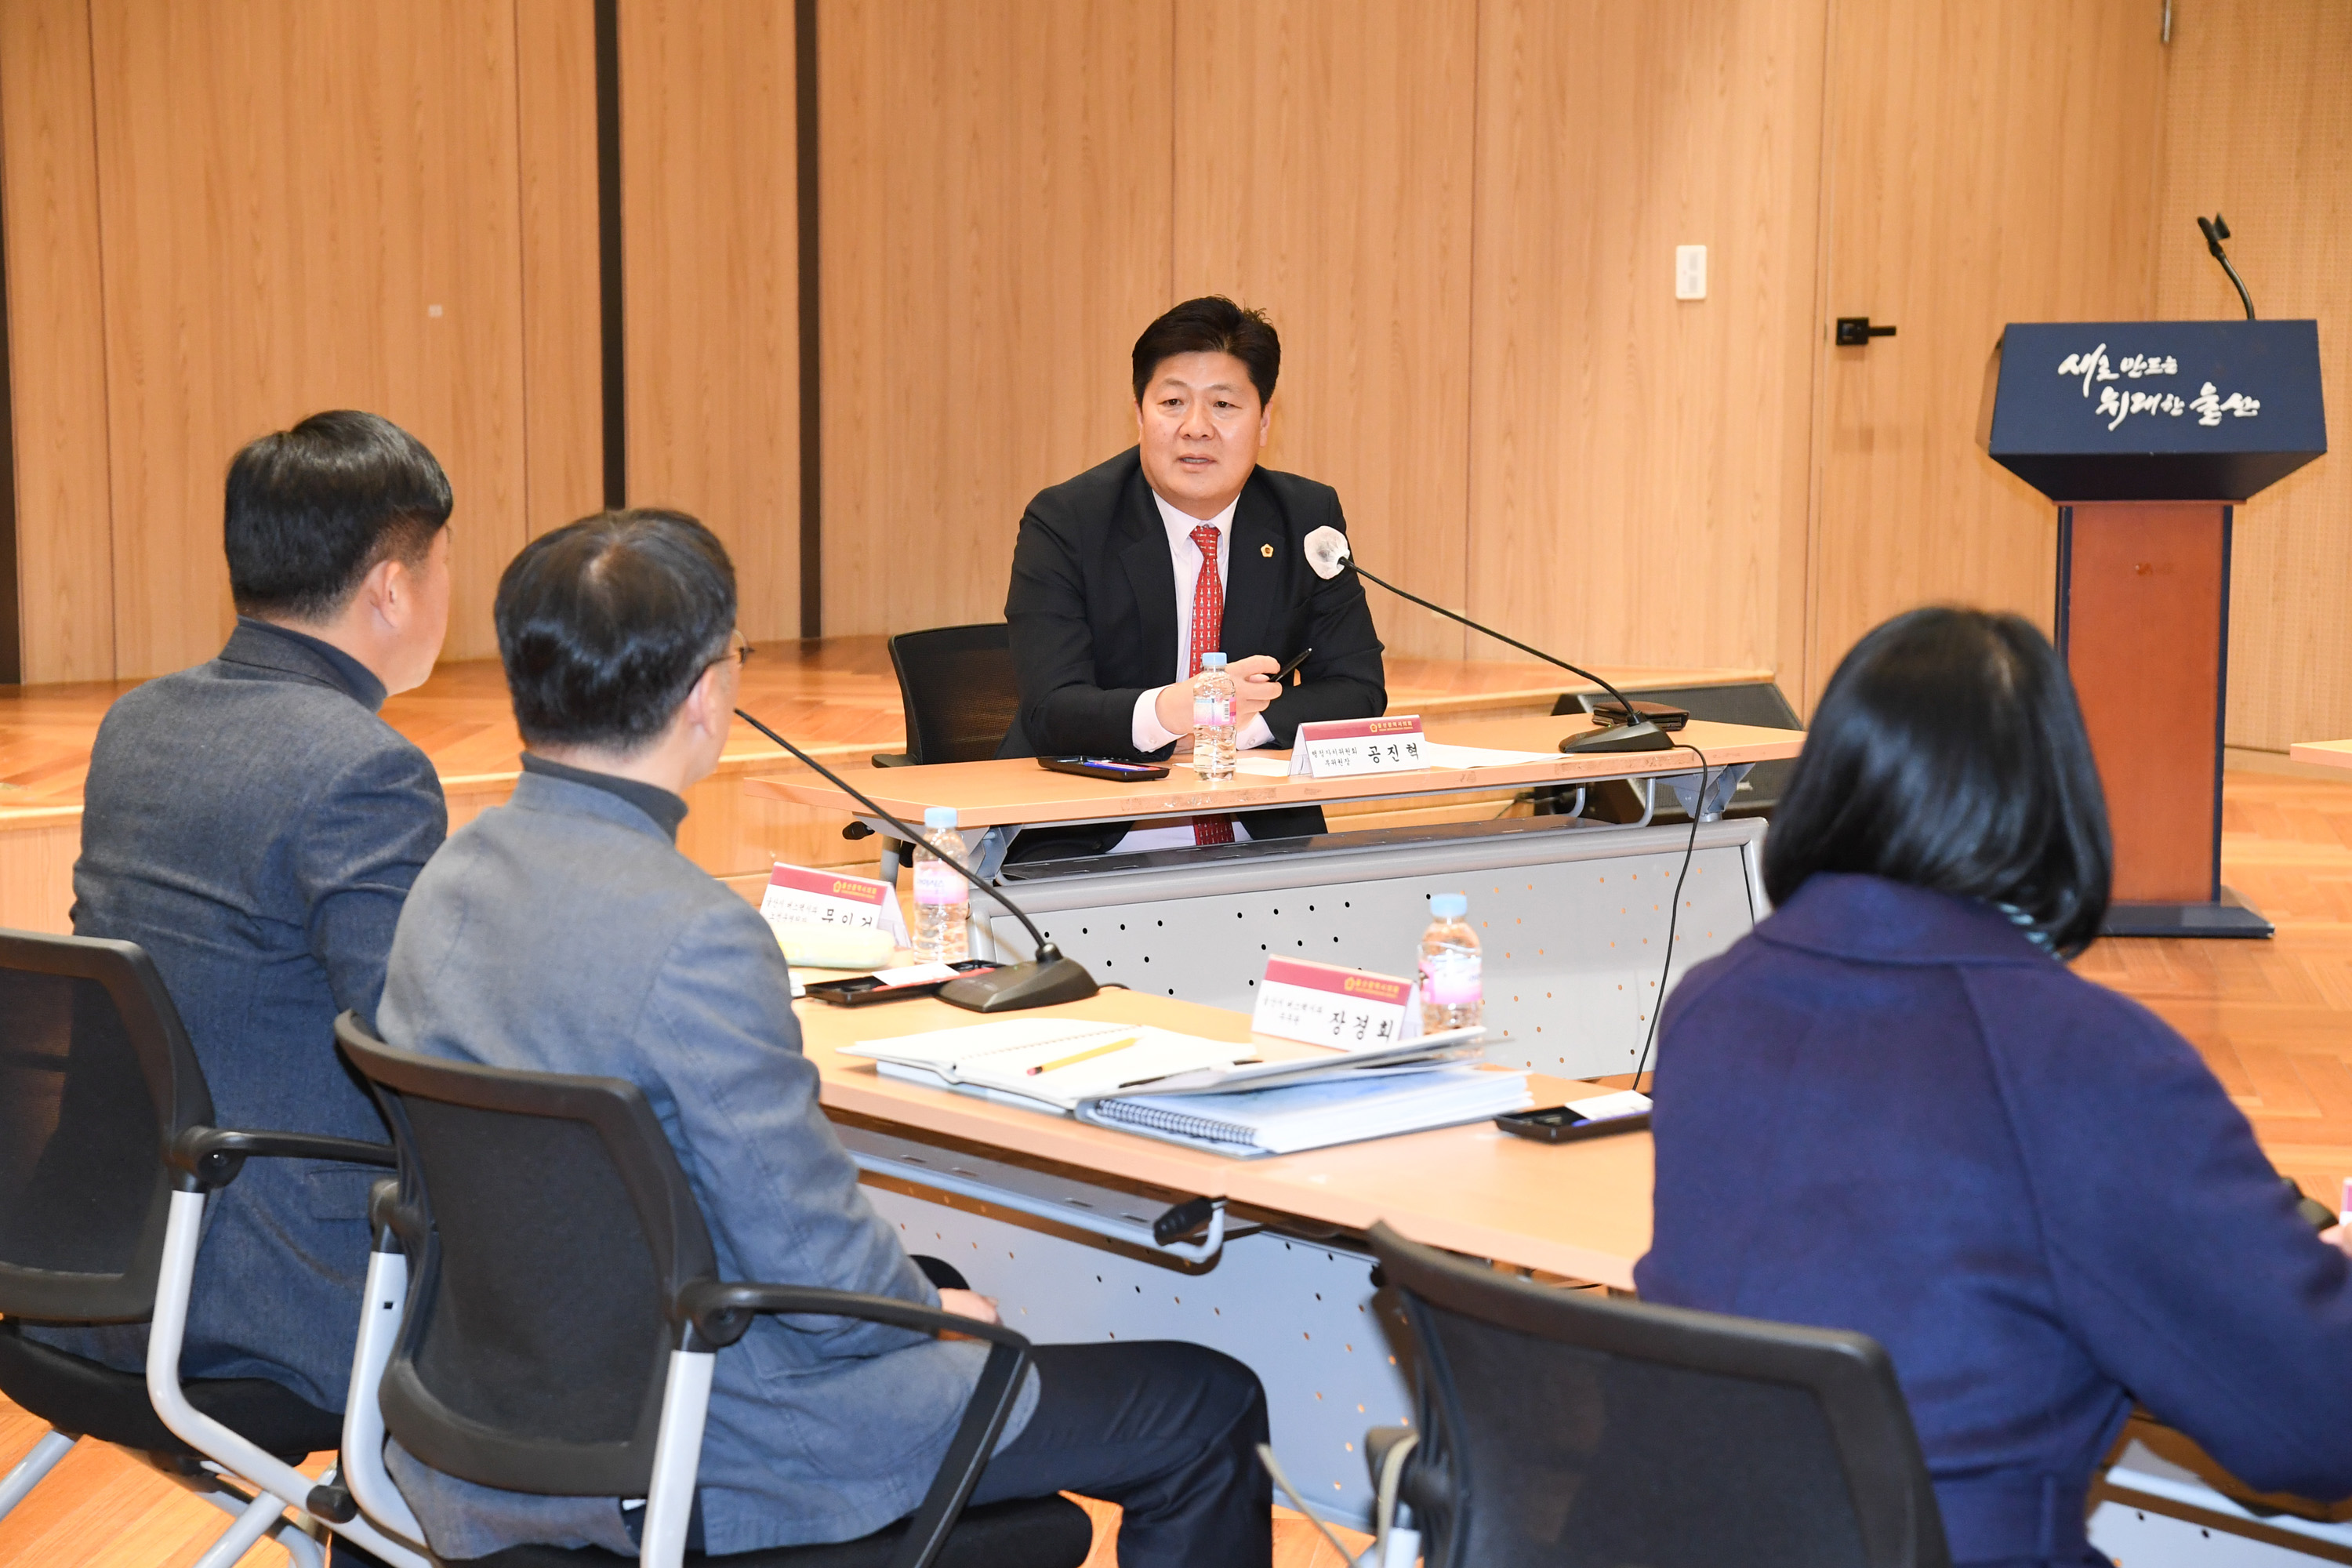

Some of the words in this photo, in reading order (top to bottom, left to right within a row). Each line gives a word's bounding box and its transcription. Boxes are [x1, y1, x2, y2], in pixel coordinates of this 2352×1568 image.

[2057, 343, 2120, 397] 새로
[2120, 354, 2178, 378] 만드는
[2095, 386, 2185, 431] 위대한
[2189, 381, 2261, 426] 울산
[1367, 742, 1420, 764] 공진혁
